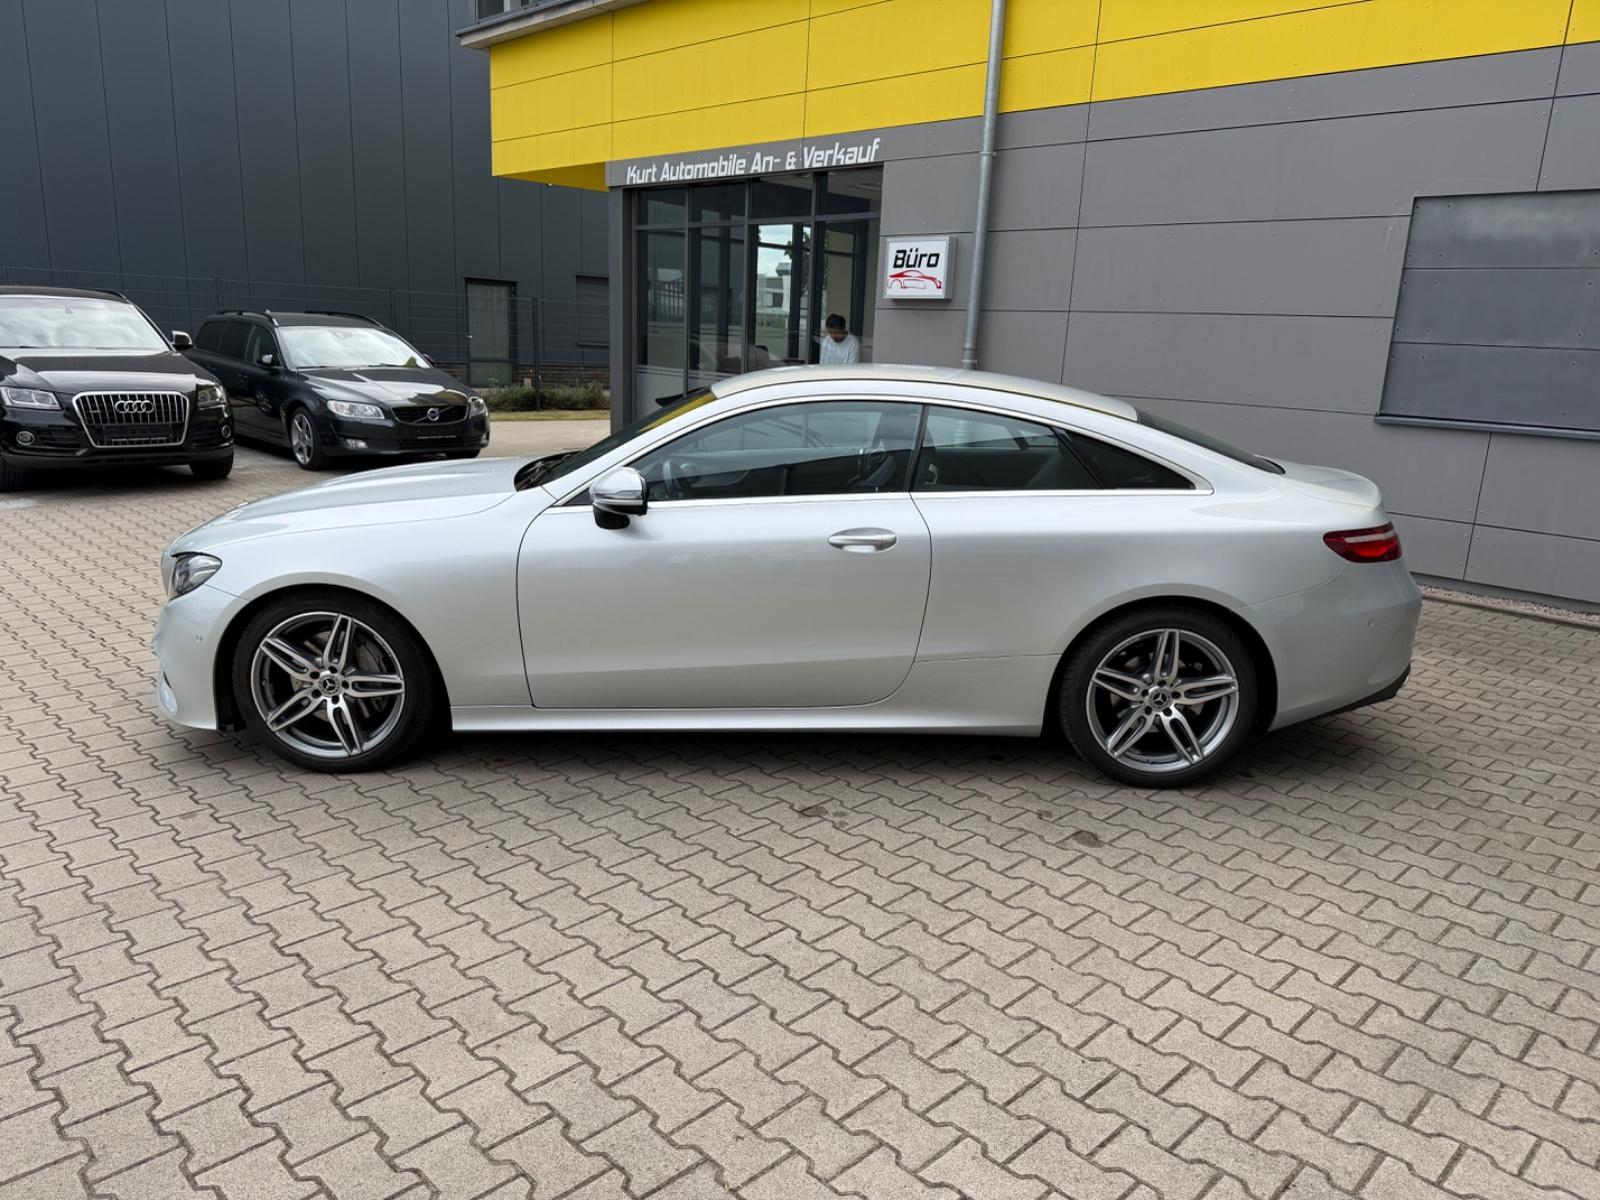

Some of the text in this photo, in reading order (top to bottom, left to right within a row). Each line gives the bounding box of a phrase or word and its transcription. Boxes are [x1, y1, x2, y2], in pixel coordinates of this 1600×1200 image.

[626, 137, 880, 185] Kurt Automobile An- & Verkauf
[893, 247, 940, 268] Büro
